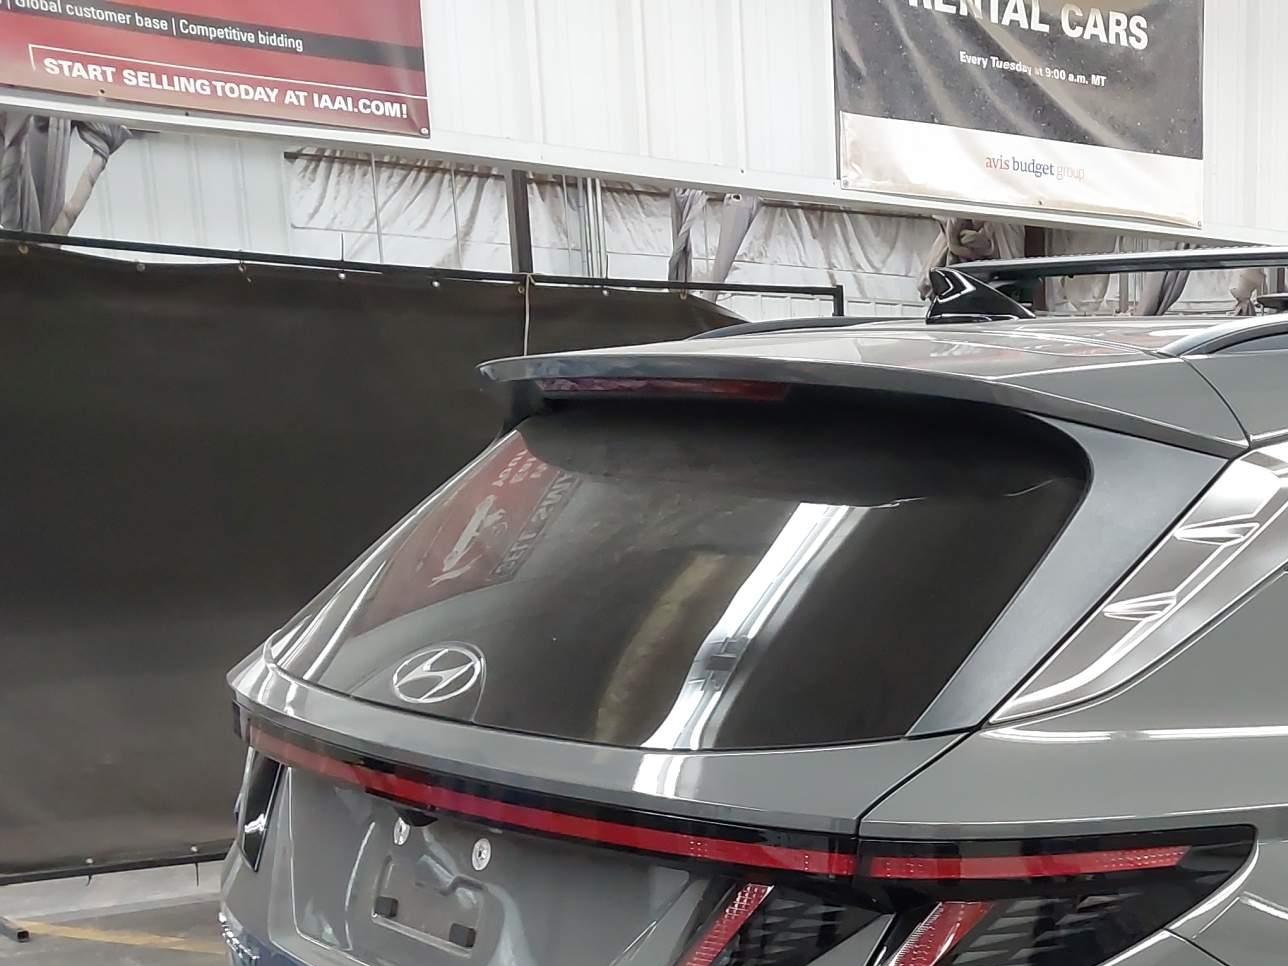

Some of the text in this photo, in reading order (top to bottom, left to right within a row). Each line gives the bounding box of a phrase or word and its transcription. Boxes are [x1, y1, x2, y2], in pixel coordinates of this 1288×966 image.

[66, 4, 131, 24] customer
[135, 12, 168, 30] base
[179, 19, 255, 43] Competitive
[257, 30, 303, 52] bidding
[1060, 4, 1149, 50] CARS
[43, 58, 408, 118] START SELLING TODAY AT IAAI.COM!
[959, 51, 988, 69] Every
[990, 56, 1032, 75] Tuesday
[1045, 68, 1066, 81] 9:00
[1068, 73, 1089, 84] a.m.
[1091, 74, 1107, 87] MT
[985, 155, 1085, 182] avis budget group
